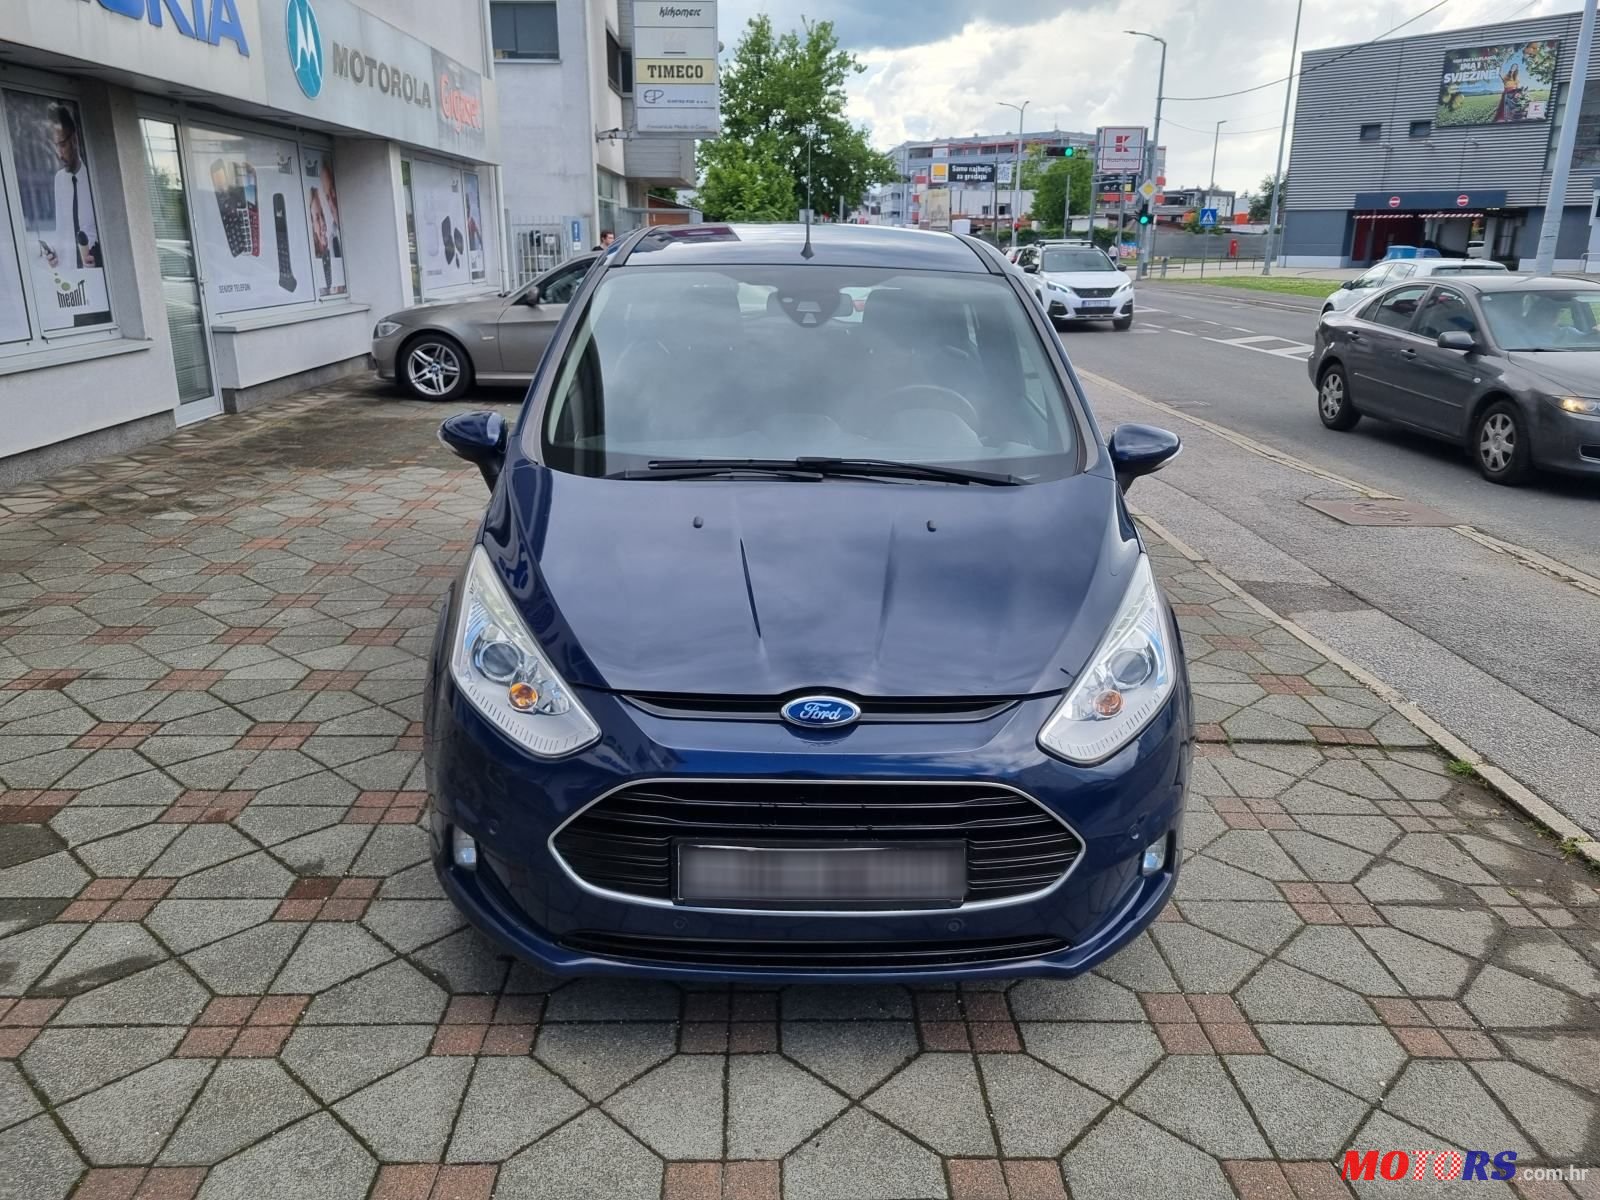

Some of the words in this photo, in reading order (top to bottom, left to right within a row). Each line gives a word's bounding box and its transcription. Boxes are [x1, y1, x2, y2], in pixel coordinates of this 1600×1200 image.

[332, 41, 432, 109] MOTOROLA
[647, 64, 704, 79] TIMECO
[800, 702, 842, 720] Ford
